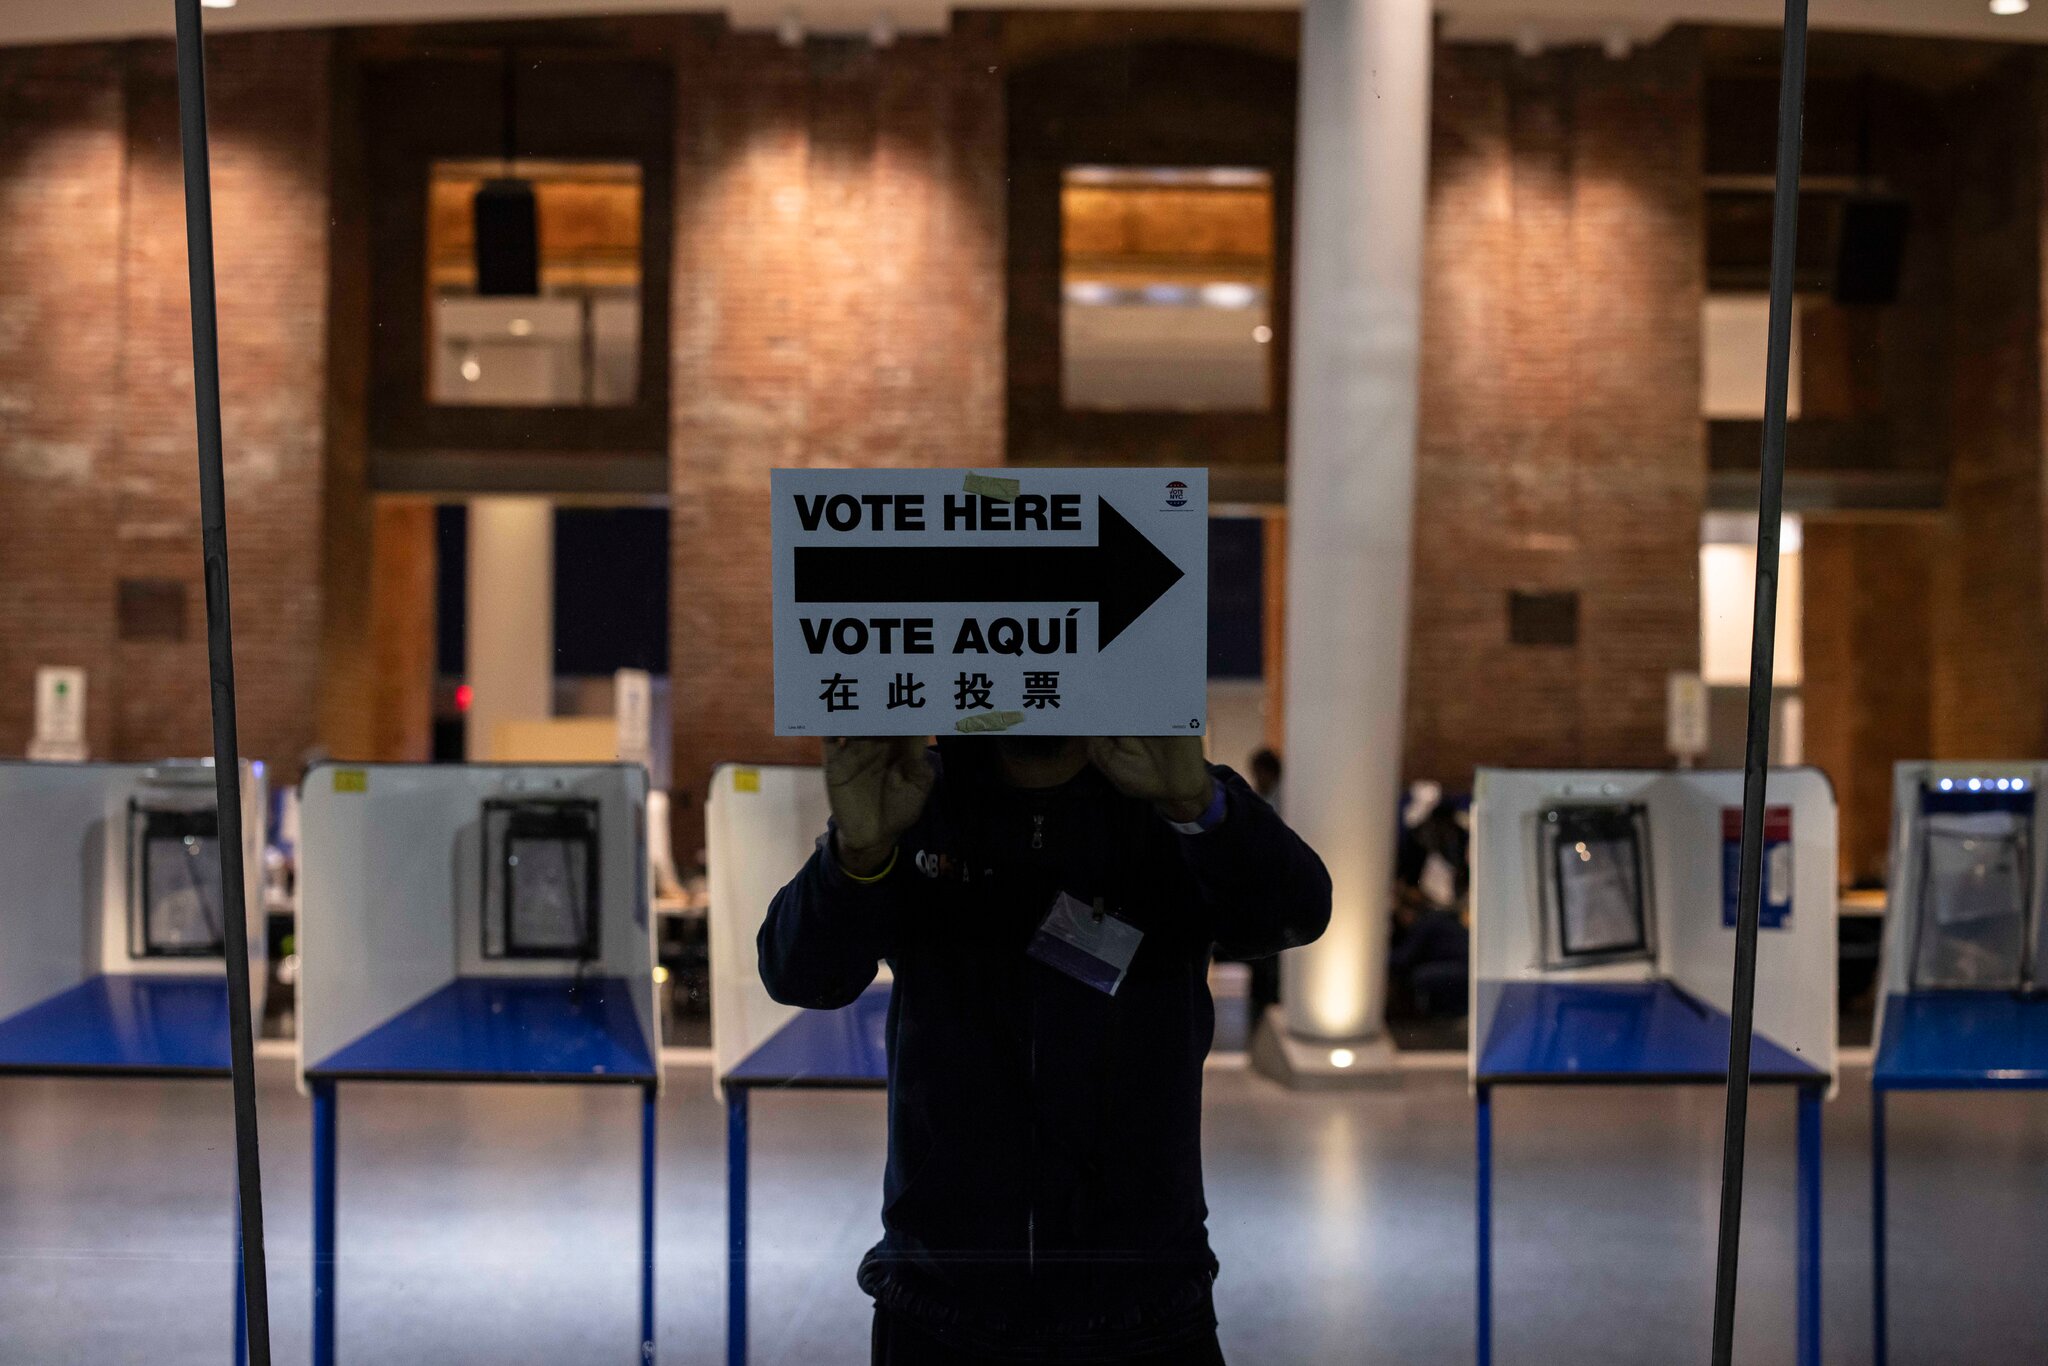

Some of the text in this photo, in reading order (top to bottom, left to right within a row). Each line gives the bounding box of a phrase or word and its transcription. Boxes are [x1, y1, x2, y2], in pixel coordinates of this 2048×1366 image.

[793, 494, 1082, 531] VOTE HERE
[799, 607, 1082, 658] VOTE AQUÍ
[819, 671, 1061, 713] 在此投票
